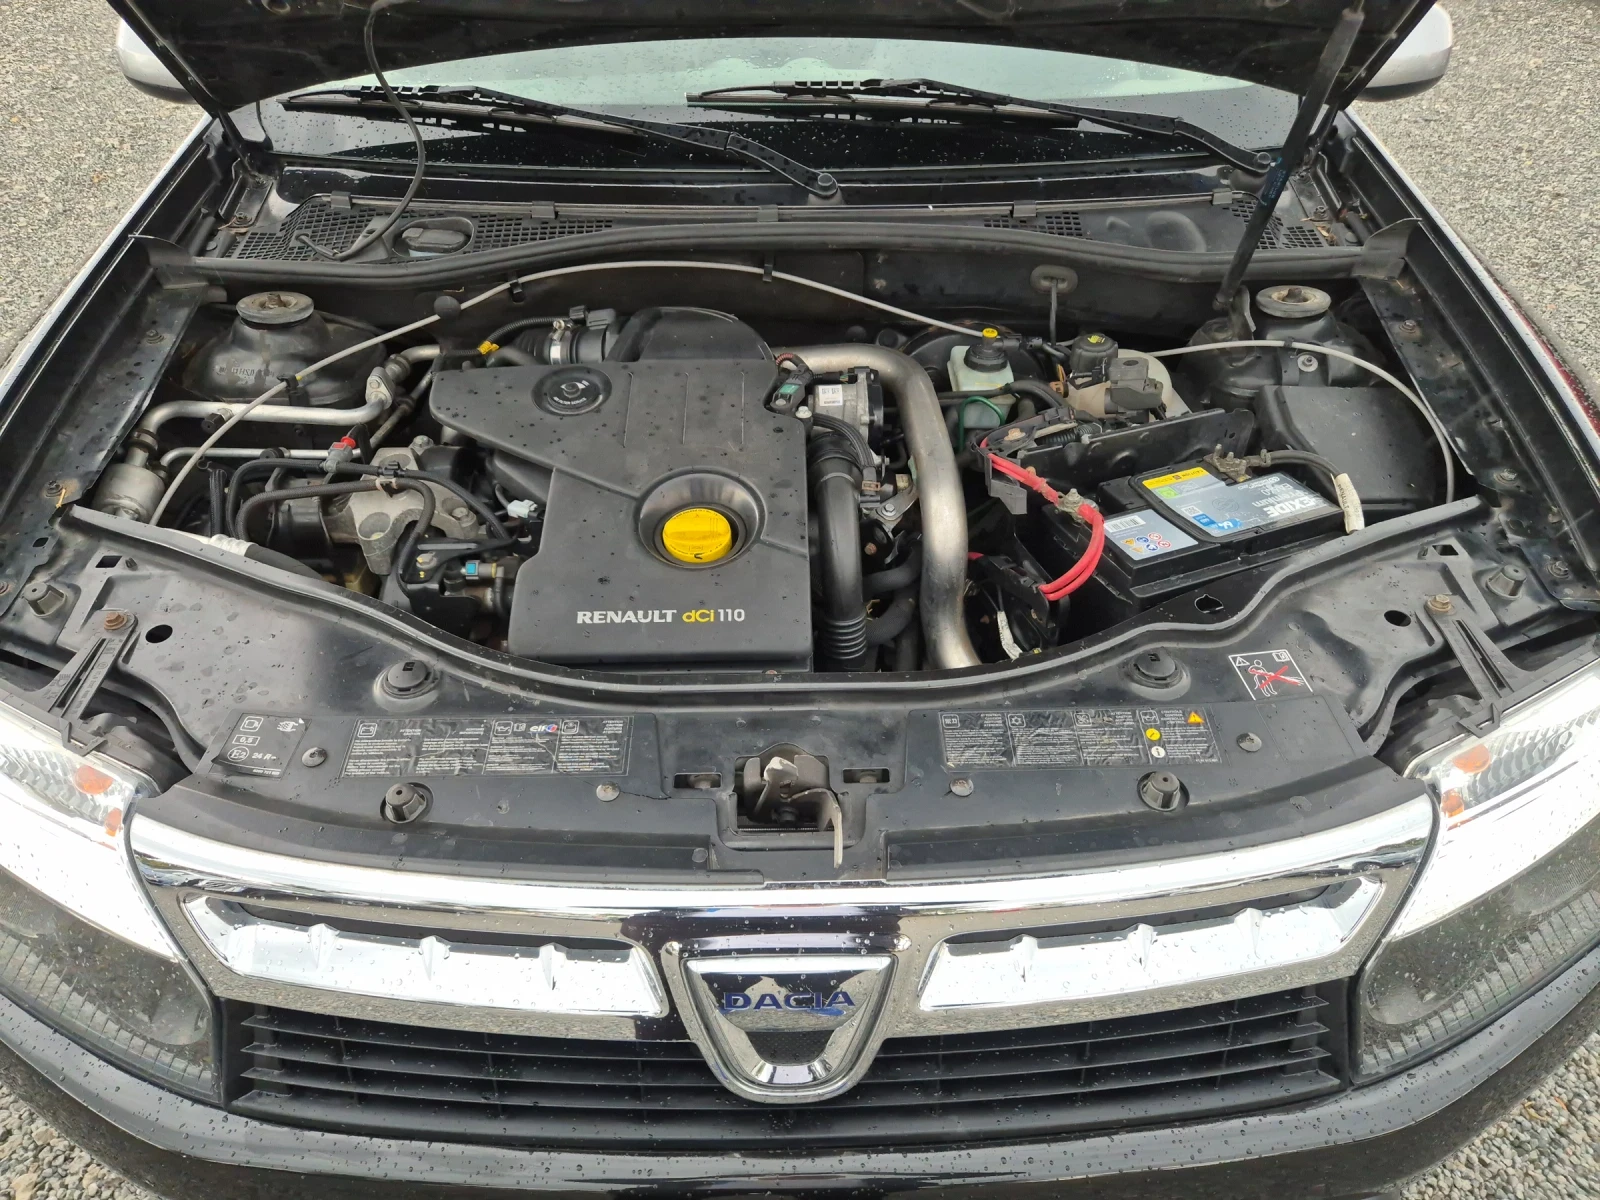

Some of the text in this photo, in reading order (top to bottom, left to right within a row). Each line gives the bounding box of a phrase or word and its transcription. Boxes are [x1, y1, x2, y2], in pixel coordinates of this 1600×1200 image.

[1252, 489, 1308, 507] Premium
[1263, 496, 1316, 518] EXIDE
[577, 608, 746, 624] RENAULT dCi 110
[530, 724, 547, 732] elf
[239, 736, 254, 744] 0,5
[230, 749, 247, 759] E2
[723, 991, 856, 1011] DACIA
